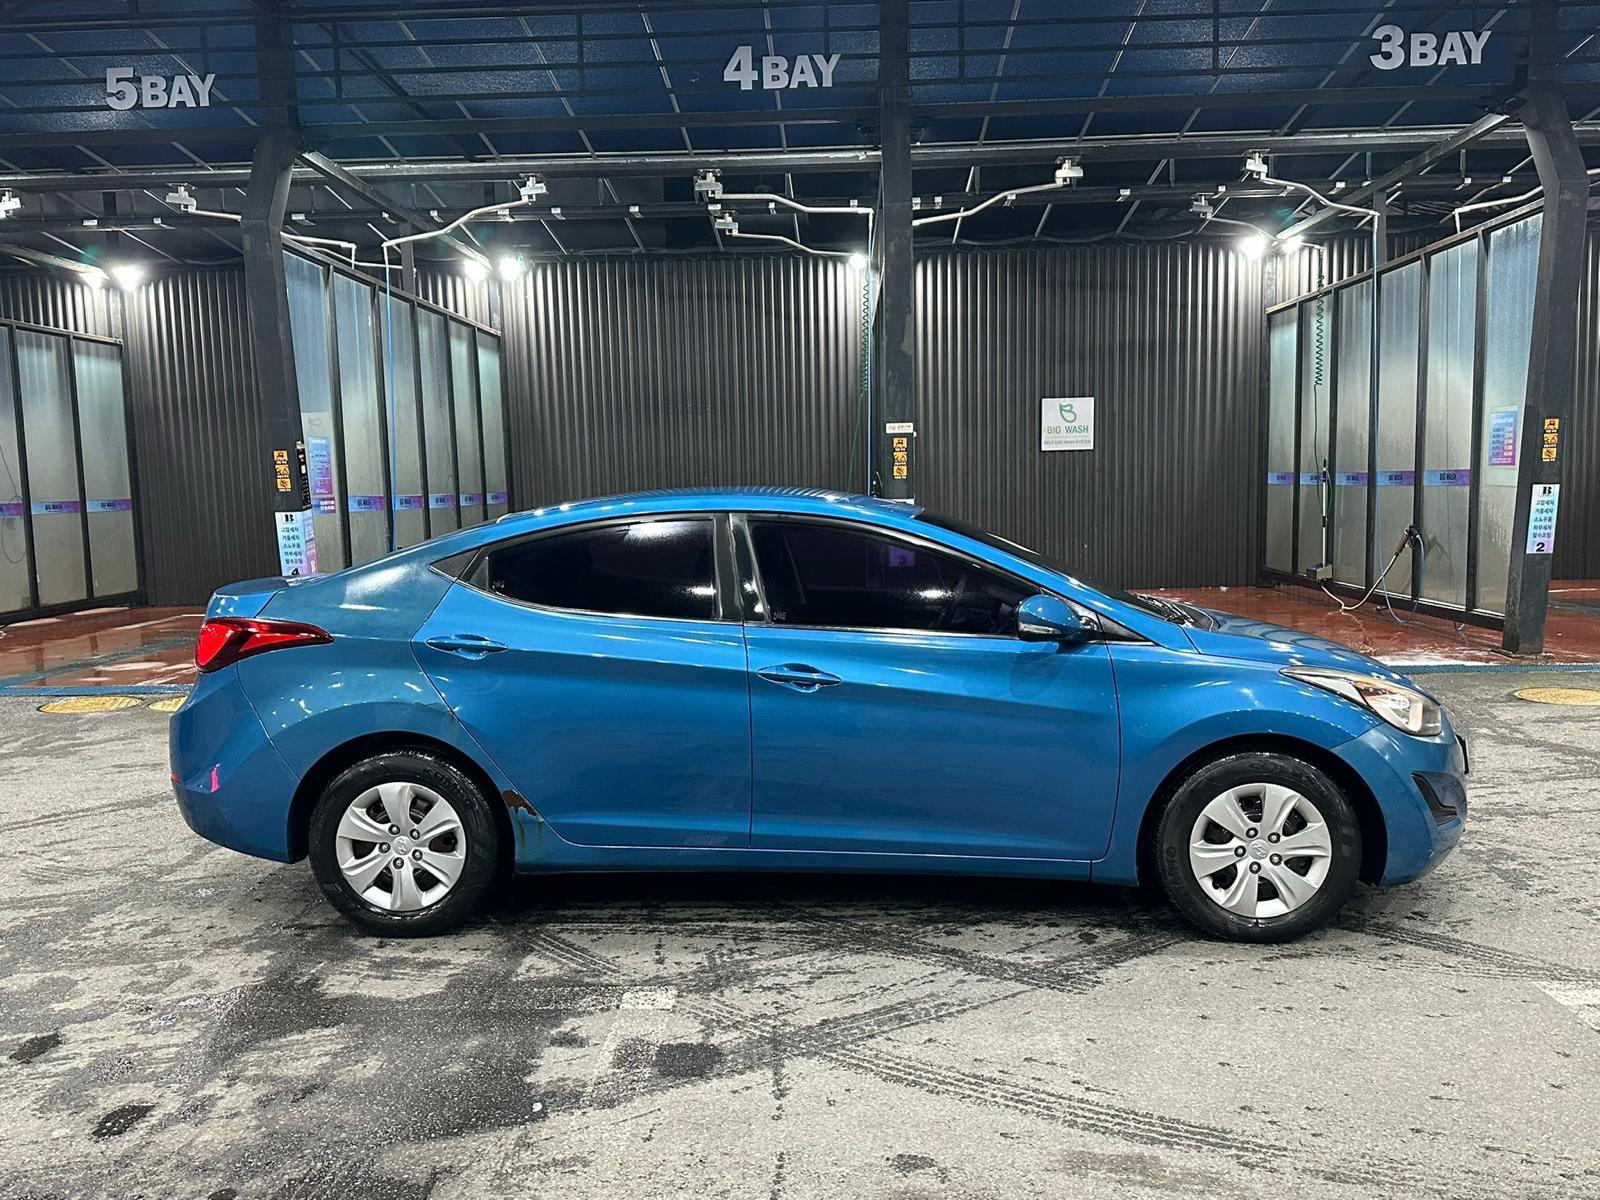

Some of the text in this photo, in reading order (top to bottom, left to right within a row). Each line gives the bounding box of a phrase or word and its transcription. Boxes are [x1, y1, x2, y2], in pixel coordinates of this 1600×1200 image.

[1047, 425, 1089, 434] BIG WASH
[1536, 542, 1545, 552] 2
